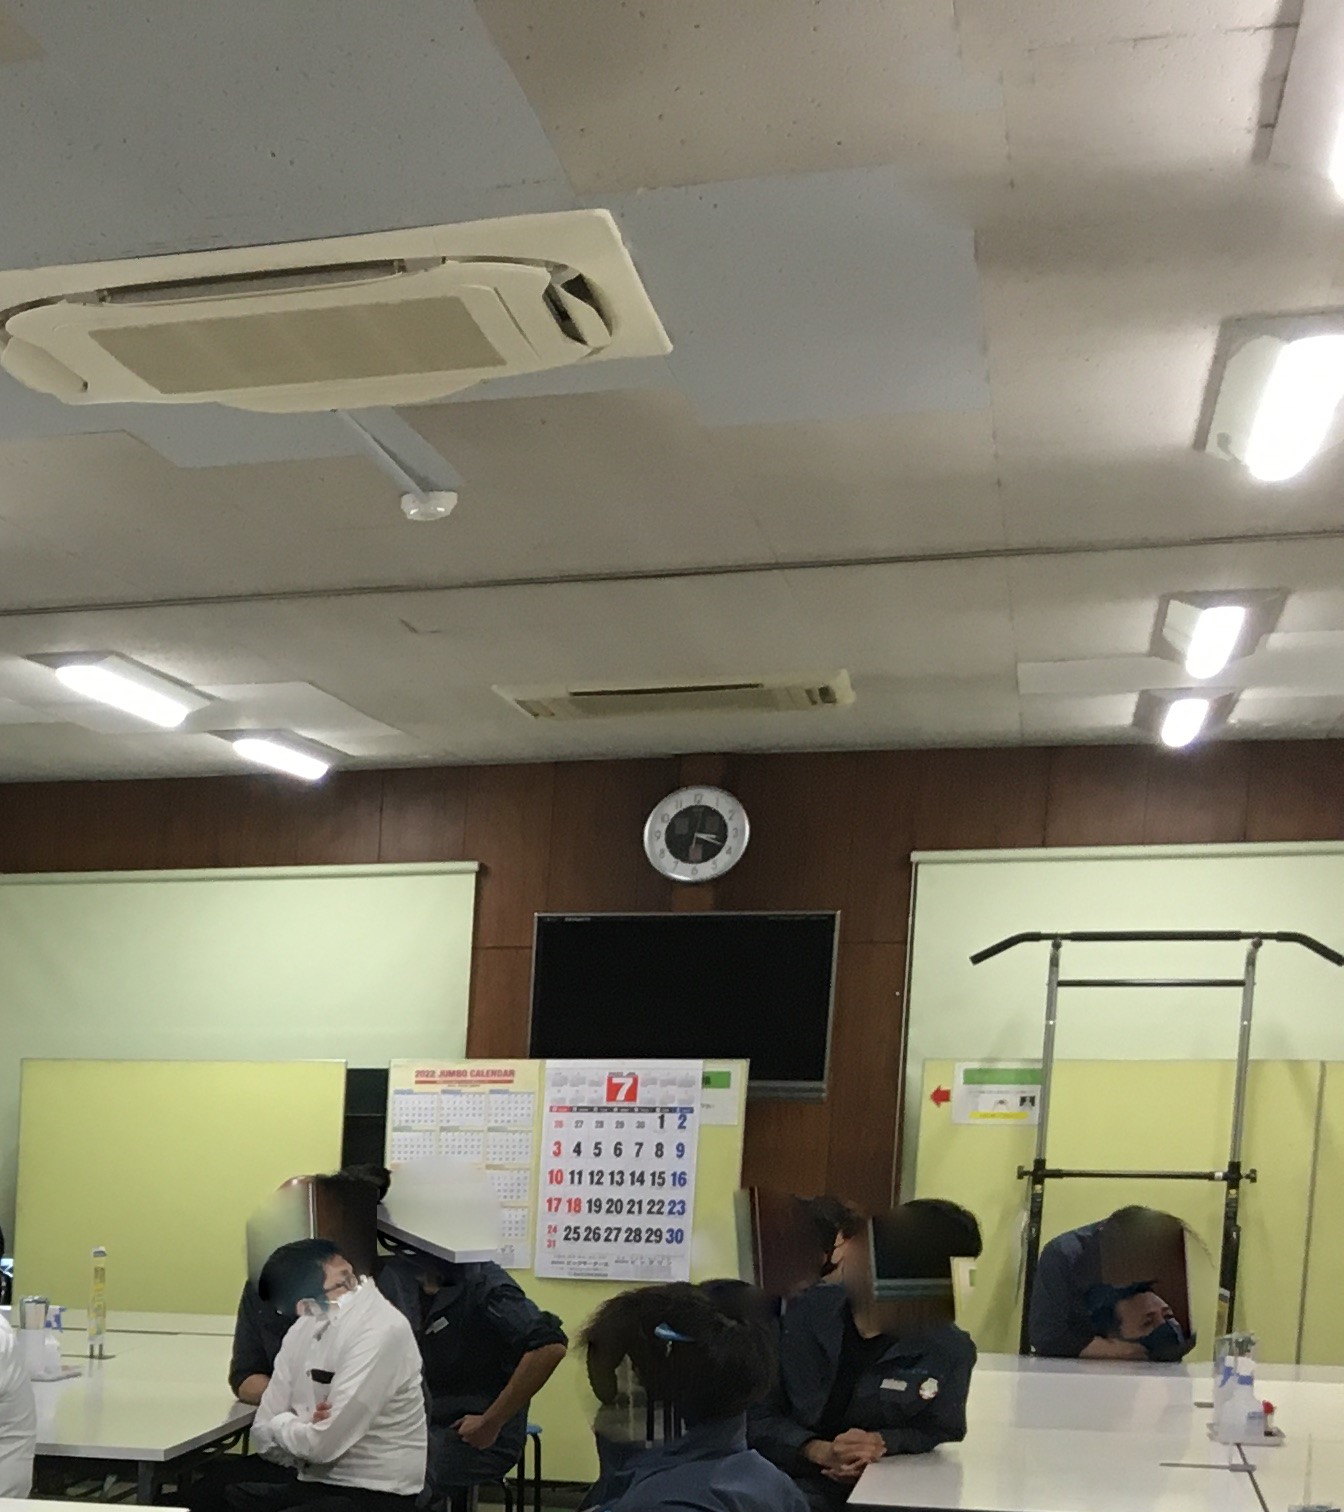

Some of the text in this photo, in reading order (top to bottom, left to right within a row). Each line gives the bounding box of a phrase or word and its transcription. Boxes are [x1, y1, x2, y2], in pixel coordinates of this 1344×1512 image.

[414, 1069, 516, 1079] 2022 JUMBO CALENDAR
[611, 1077, 633, 1102] 7
[657, 1114, 665, 1129] 1
[677, 1114, 687, 1130] 2
[552, 1140, 686, 1158] 3 4 5 6 7 8 9
[548, 1169, 687, 1187] 10 11 12 13 14 15 16
[546, 1197, 686, 1216] 17 18 19 20 21 22 23
[547, 1225, 558, 1234] 24
[563, 1225, 684, 1244] 25 26 27 28 29 30
[546, 1239, 556, 1248] 31
